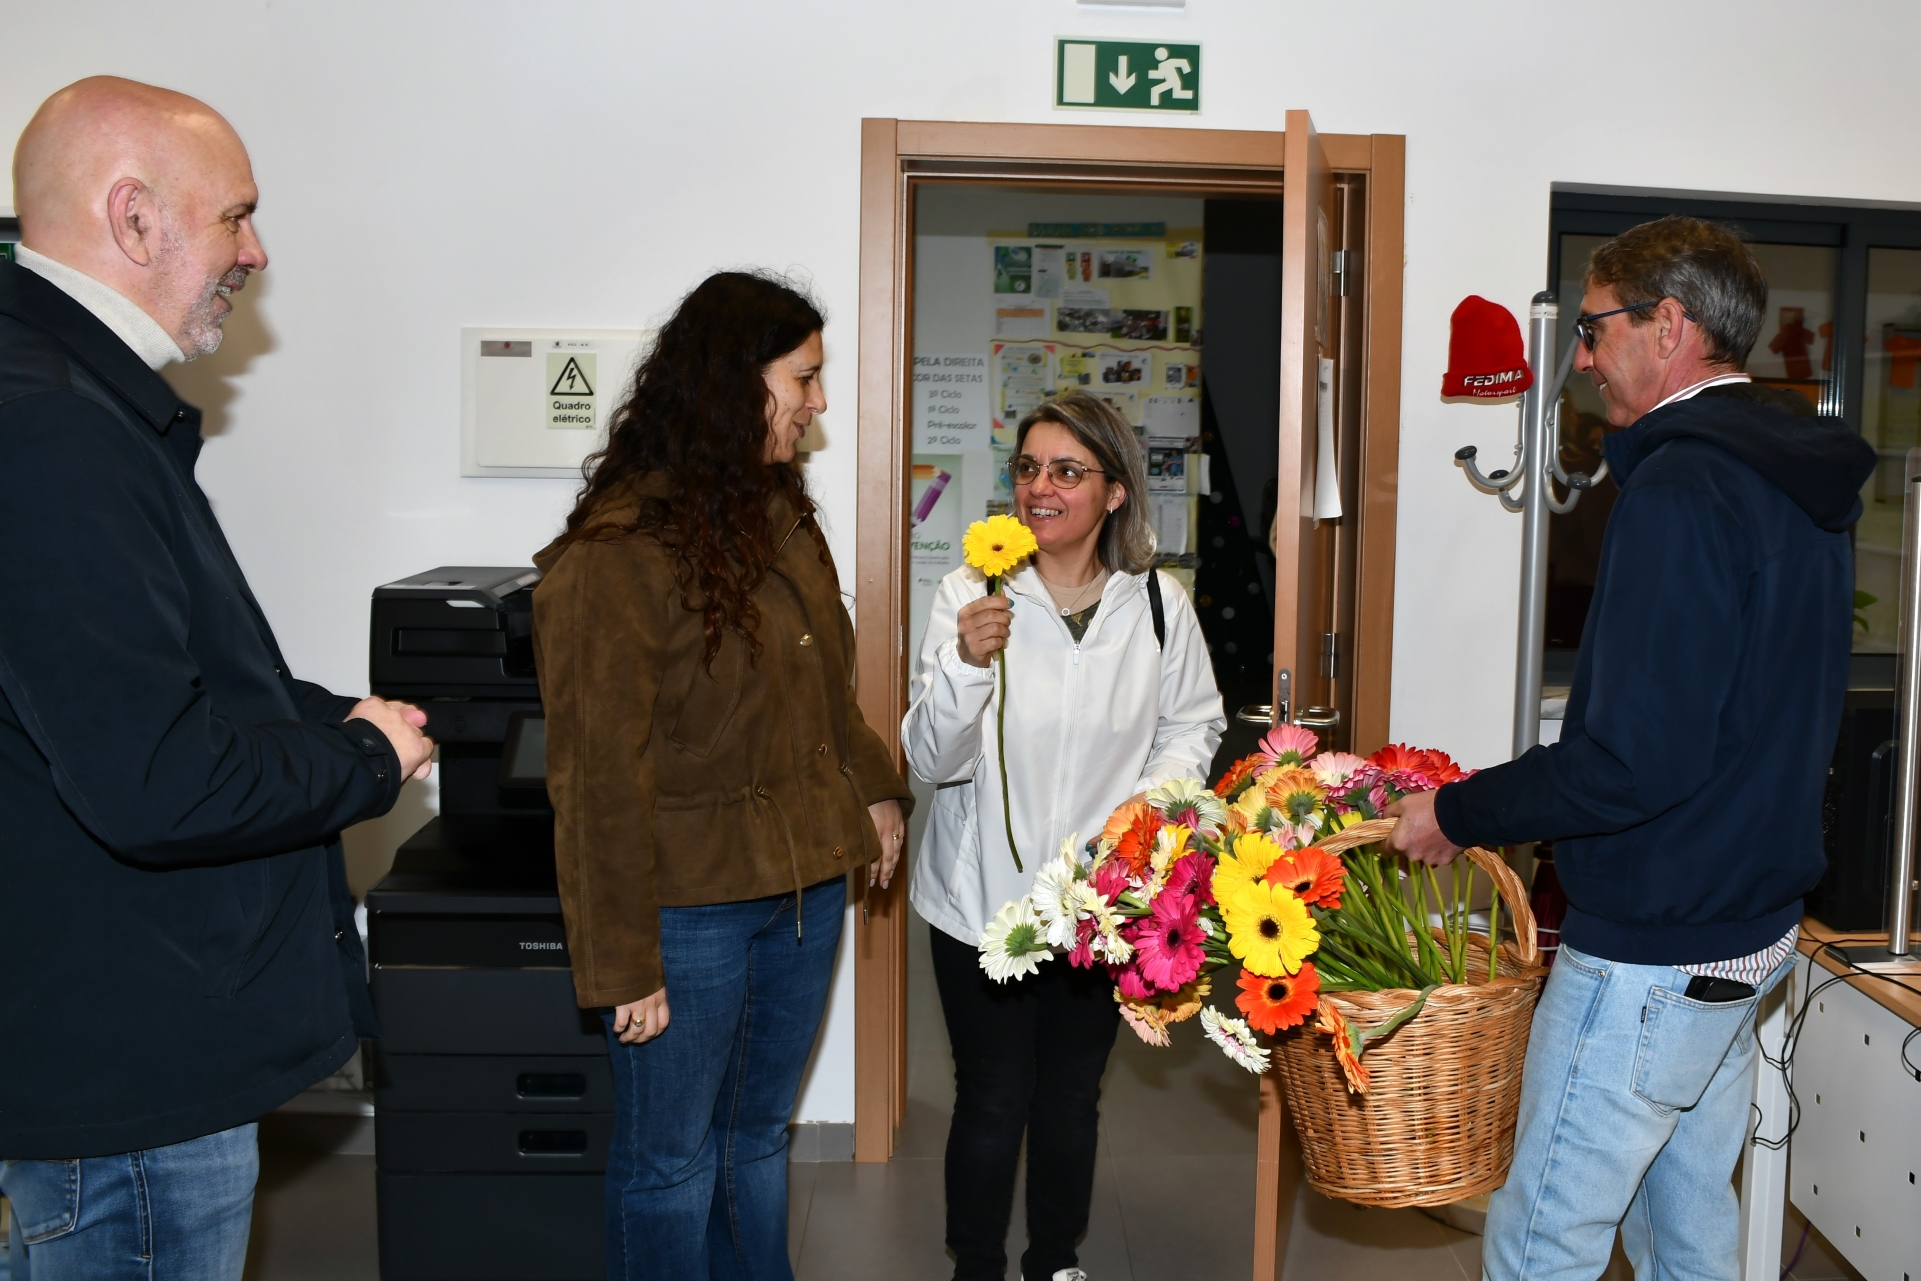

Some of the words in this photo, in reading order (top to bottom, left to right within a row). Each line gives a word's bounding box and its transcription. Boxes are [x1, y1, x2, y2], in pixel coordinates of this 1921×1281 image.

[913, 357, 940, 366] PELA
[944, 357, 984, 367] DIREITA
[932, 374, 952, 382] DAS
[955, 374, 983, 382] SETAS
[1464, 370, 1523, 386] FEDIMA
[940, 390, 962, 398] Ciclo
[552, 400, 591, 410] Quadro
[938, 405, 960, 414] Ciclo
[552, 414, 591, 424] elétrico
[940, 436, 962, 444] Ciclo
[519, 942, 563, 950] TOSHIBA
